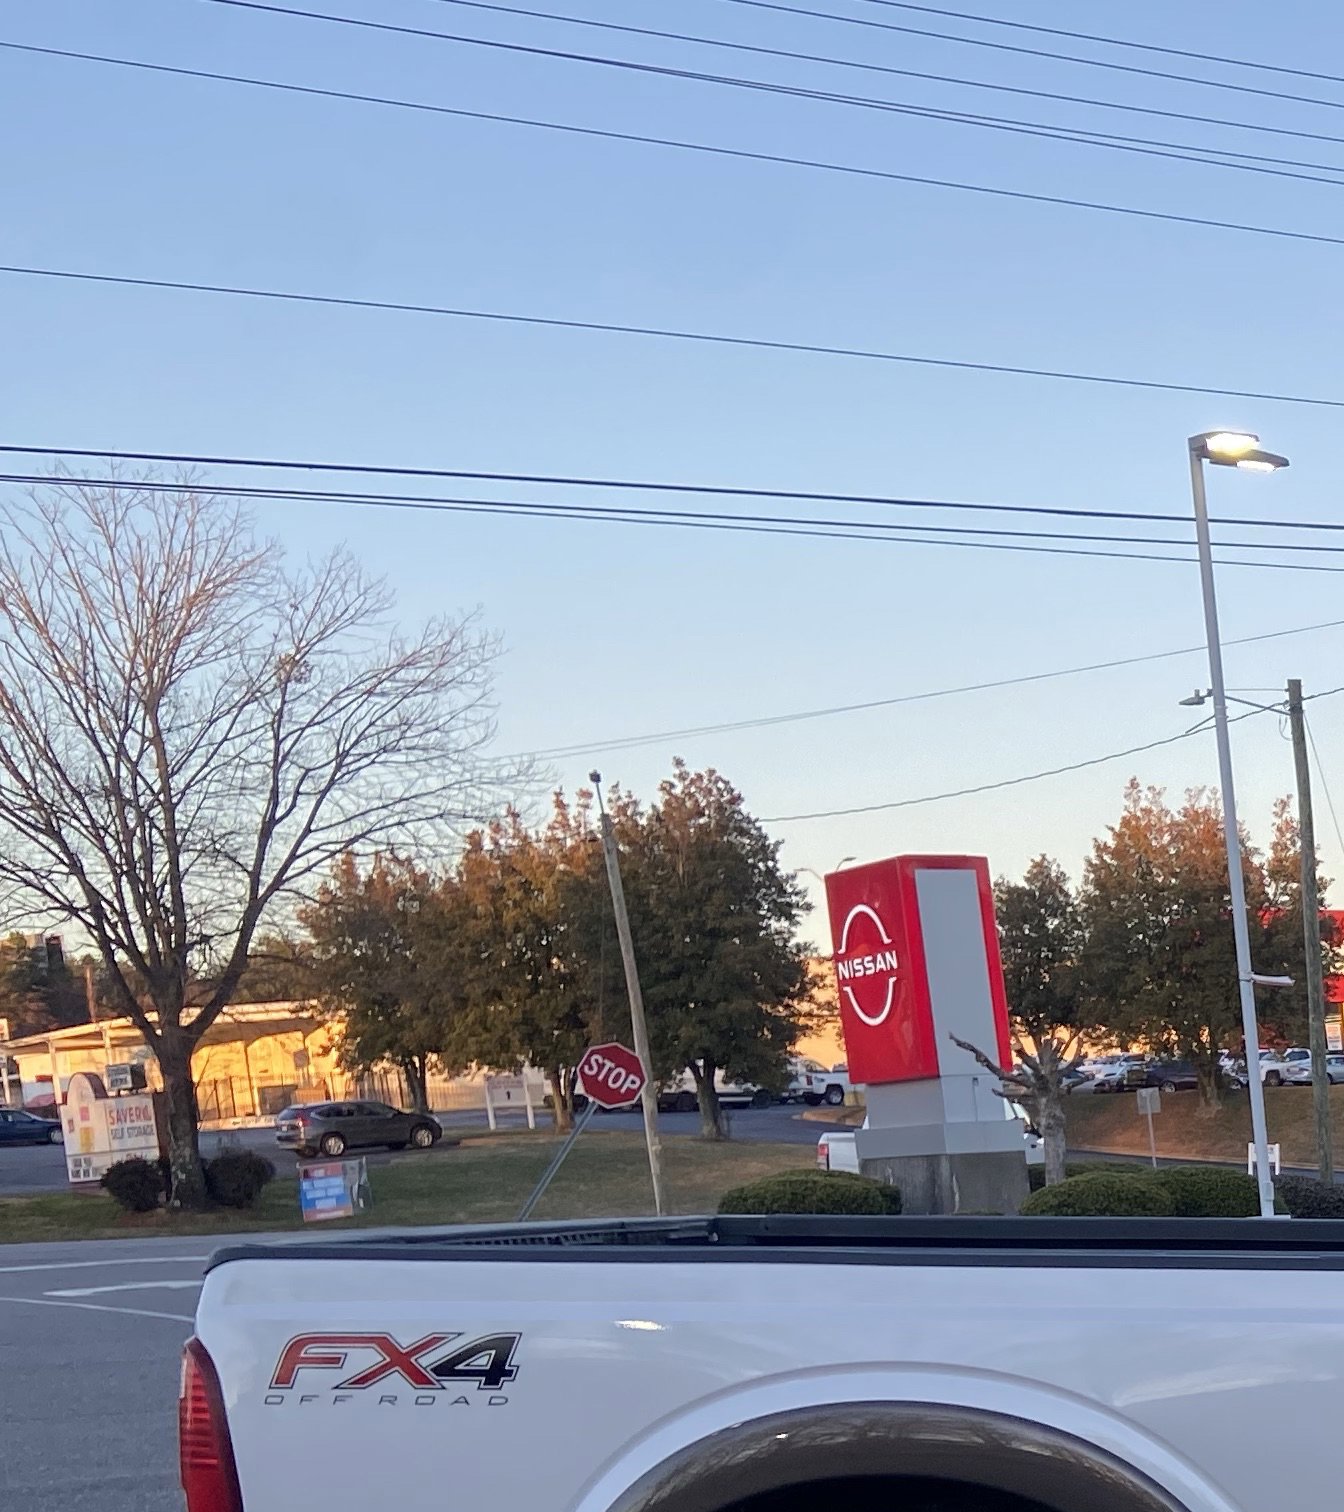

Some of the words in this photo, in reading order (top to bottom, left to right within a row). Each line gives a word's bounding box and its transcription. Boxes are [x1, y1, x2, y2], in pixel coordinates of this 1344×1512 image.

[838, 950, 898, 980] NISSAN
[584, 1053, 641, 1094] STOP
[269, 1331, 523, 1391] FX4
[264, 1395, 353, 1406] OFF
[379, 1395, 509, 1406] ROAD
